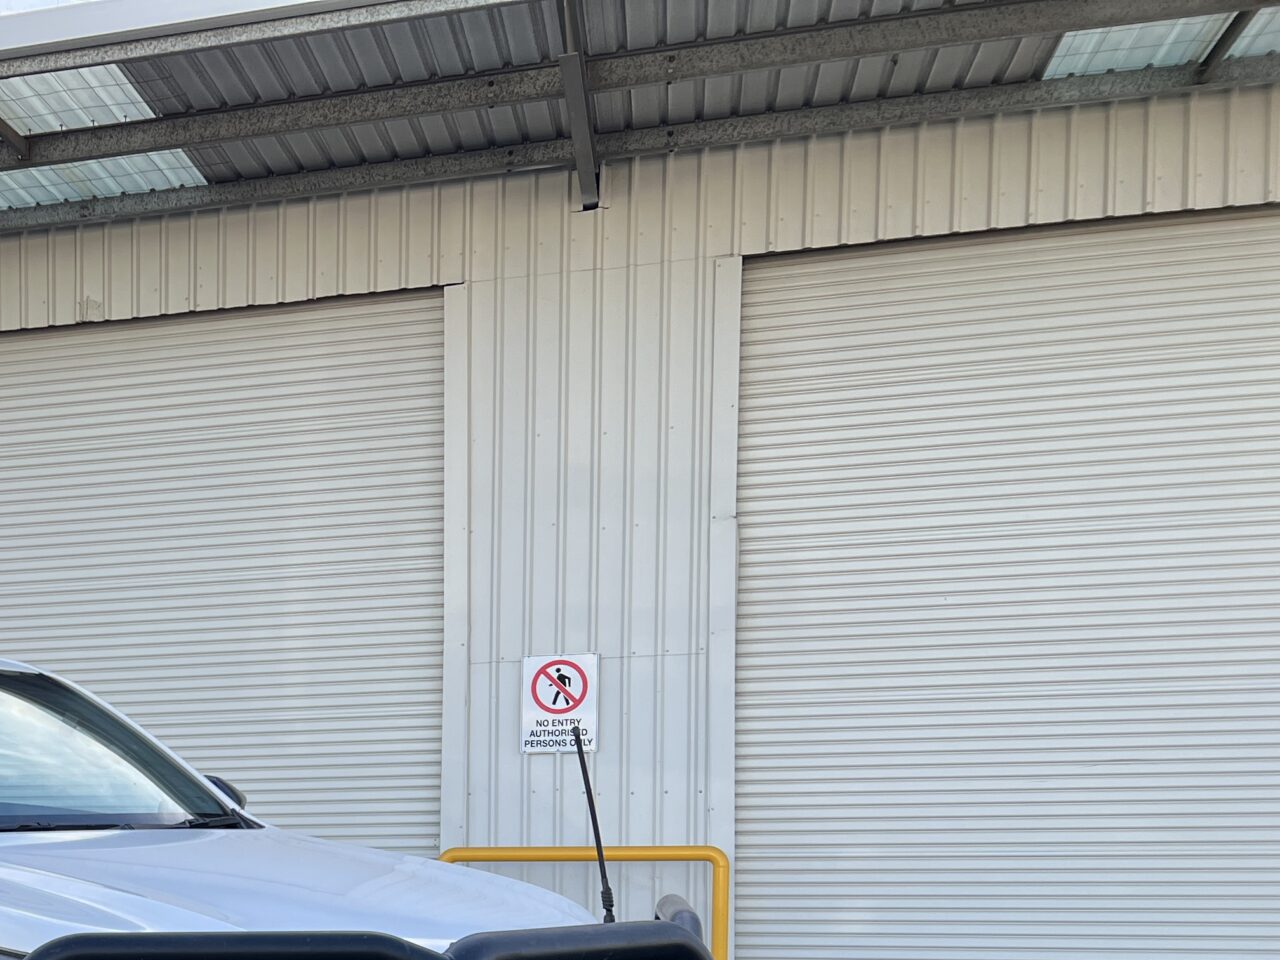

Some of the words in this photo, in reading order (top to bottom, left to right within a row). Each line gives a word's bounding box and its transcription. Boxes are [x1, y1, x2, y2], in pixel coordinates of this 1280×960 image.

[536, 719, 549, 727] NO
[552, 718, 582, 727] ENTRY
[529, 728, 588, 738] AUTHORISD
[524, 739, 567, 748] PERSONS
[569, 738, 593, 747] OLY
